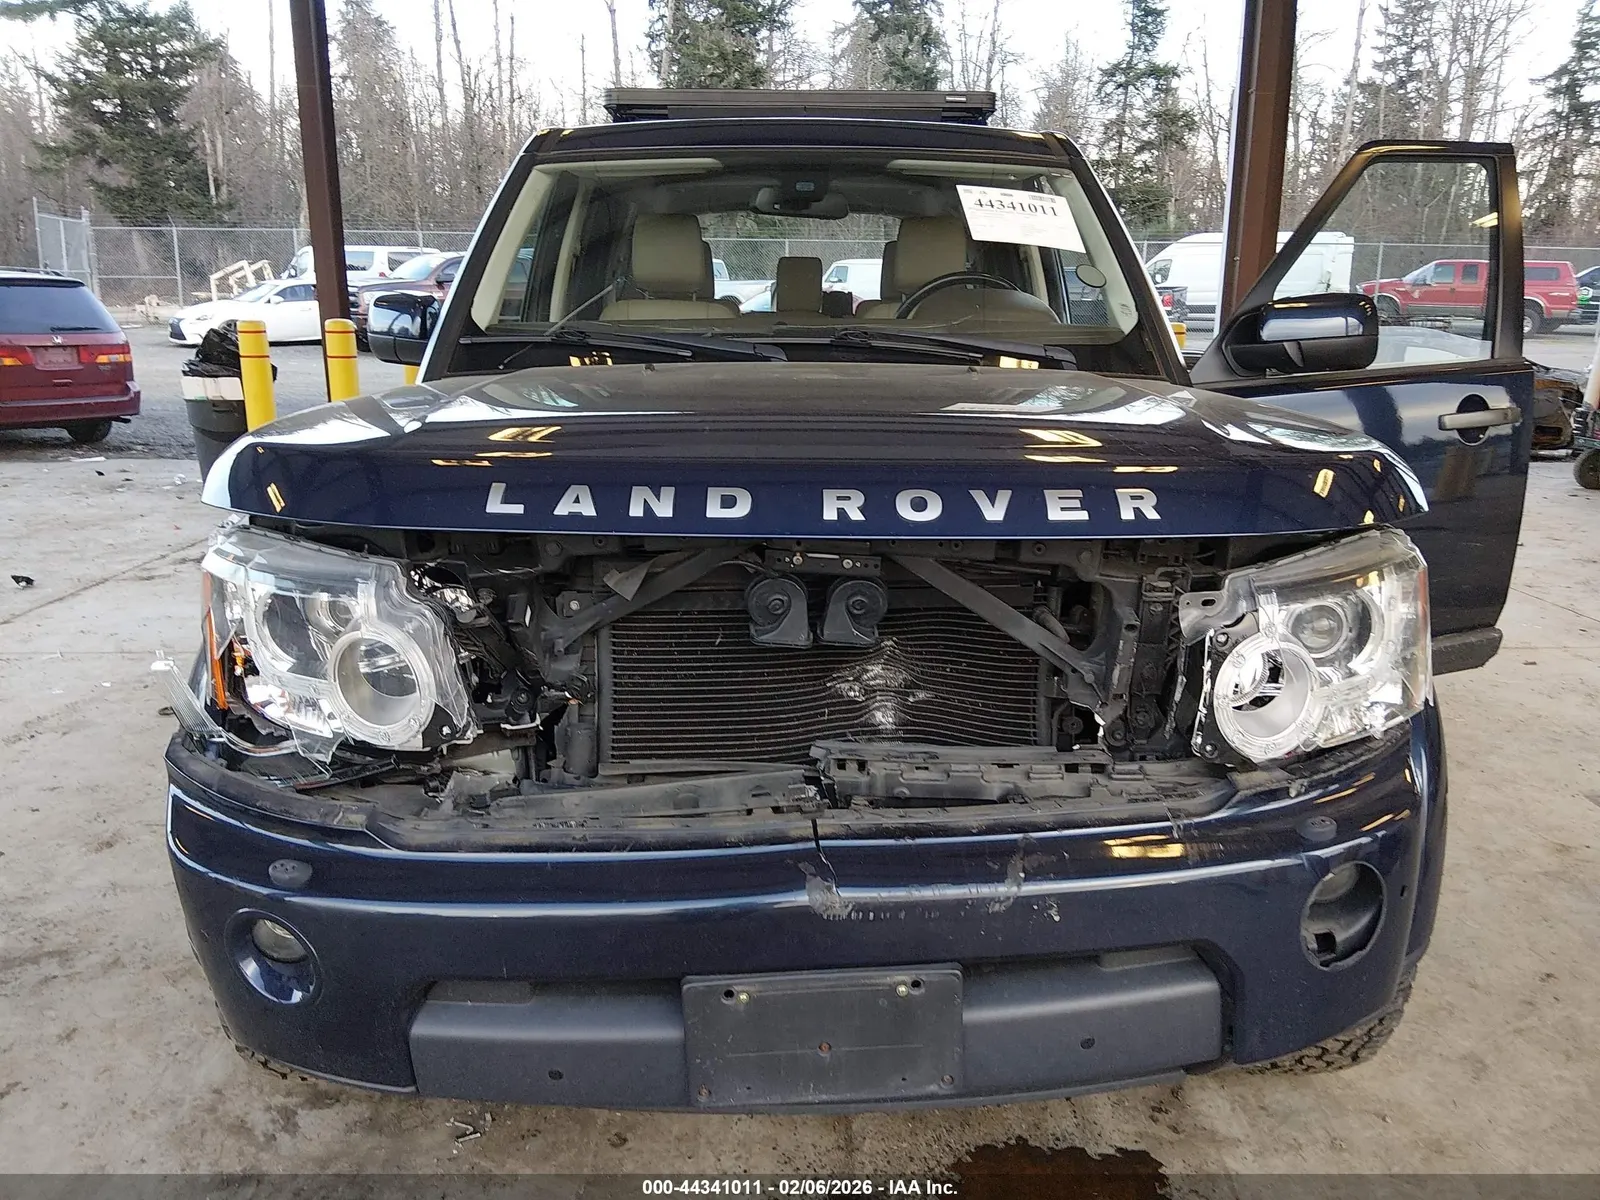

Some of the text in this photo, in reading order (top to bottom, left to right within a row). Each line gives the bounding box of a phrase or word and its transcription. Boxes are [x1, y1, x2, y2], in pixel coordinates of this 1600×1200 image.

[974, 198, 1058, 217] 44341011
[485, 482, 1163, 522] LAND ROVER
